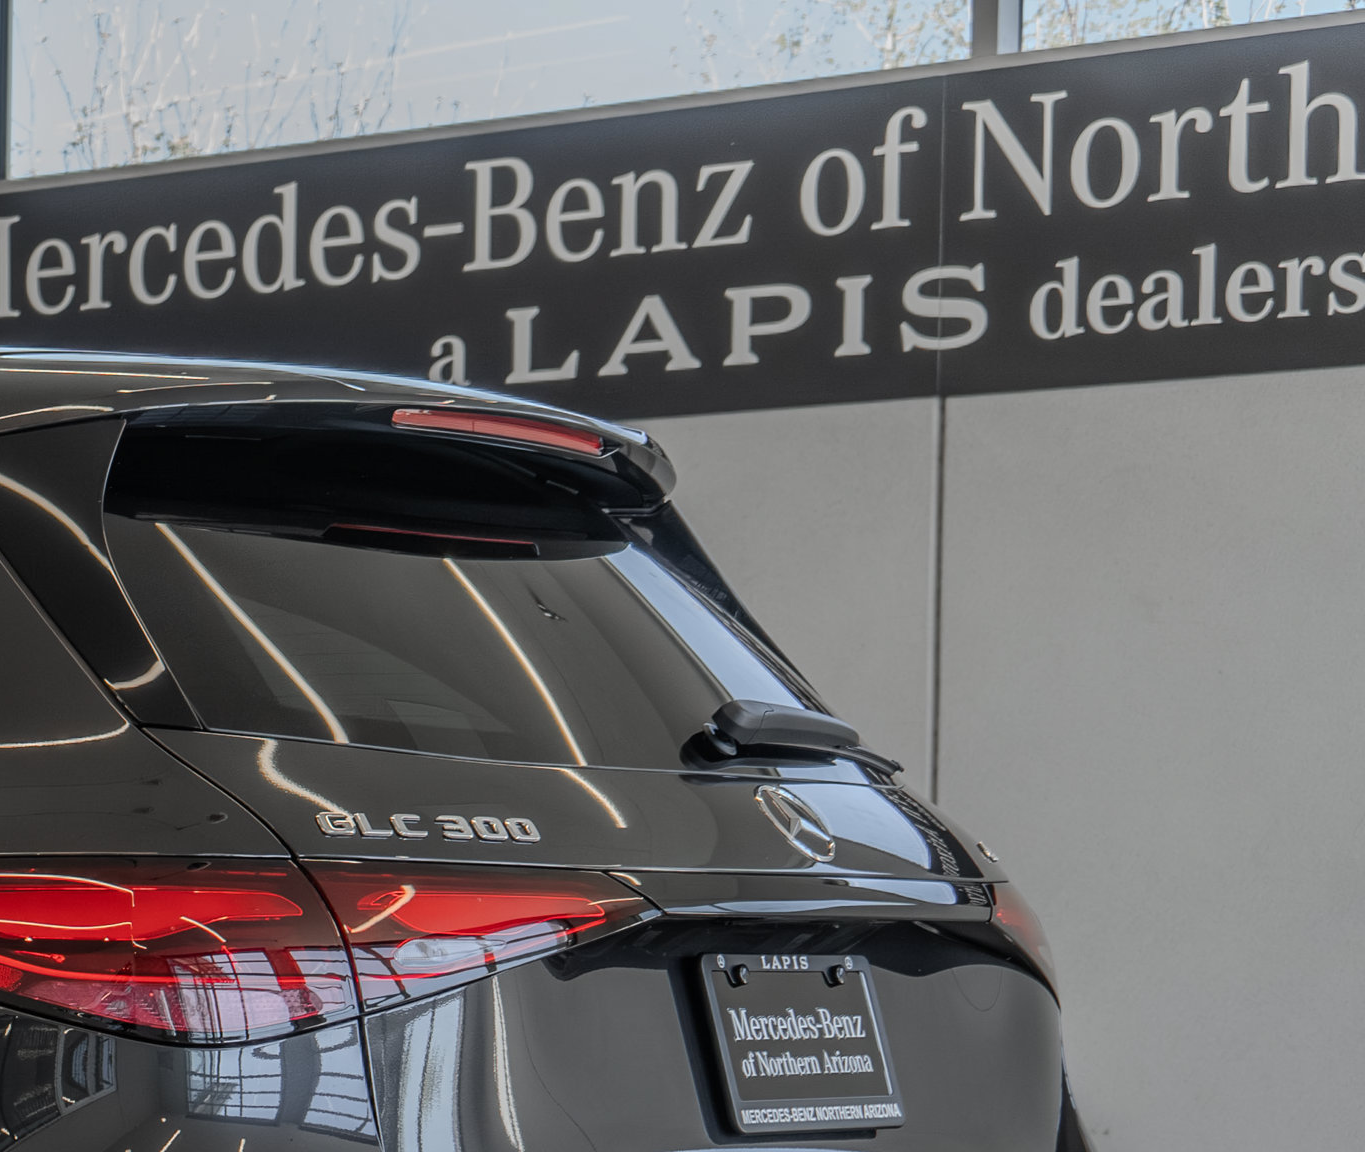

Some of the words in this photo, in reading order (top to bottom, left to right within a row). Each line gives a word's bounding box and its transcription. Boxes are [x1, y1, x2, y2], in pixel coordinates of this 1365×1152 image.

[800, 105, 927, 237] of
[958, 58, 1365, 221] North
[428, 335, 469, 385] a
[504, 263, 989, 384] LAPIS
[317, 811, 429, 839] GLC
[436, 815, 541, 843] 300
[761, 955, 809, 969] LAPIS
[727, 1007, 866, 1042] Mercedes-Benz
[741, 1051, 757, 1078] of
[757, 1052, 822, 1077] Northern
[823, 1050, 873, 1075] Arizona
[741, 1106, 815, 1124] MERCEDES-BENZ
[815, 1105, 863, 1122] NORTHERN
[863, 1103, 902, 1119] ARIZONA
